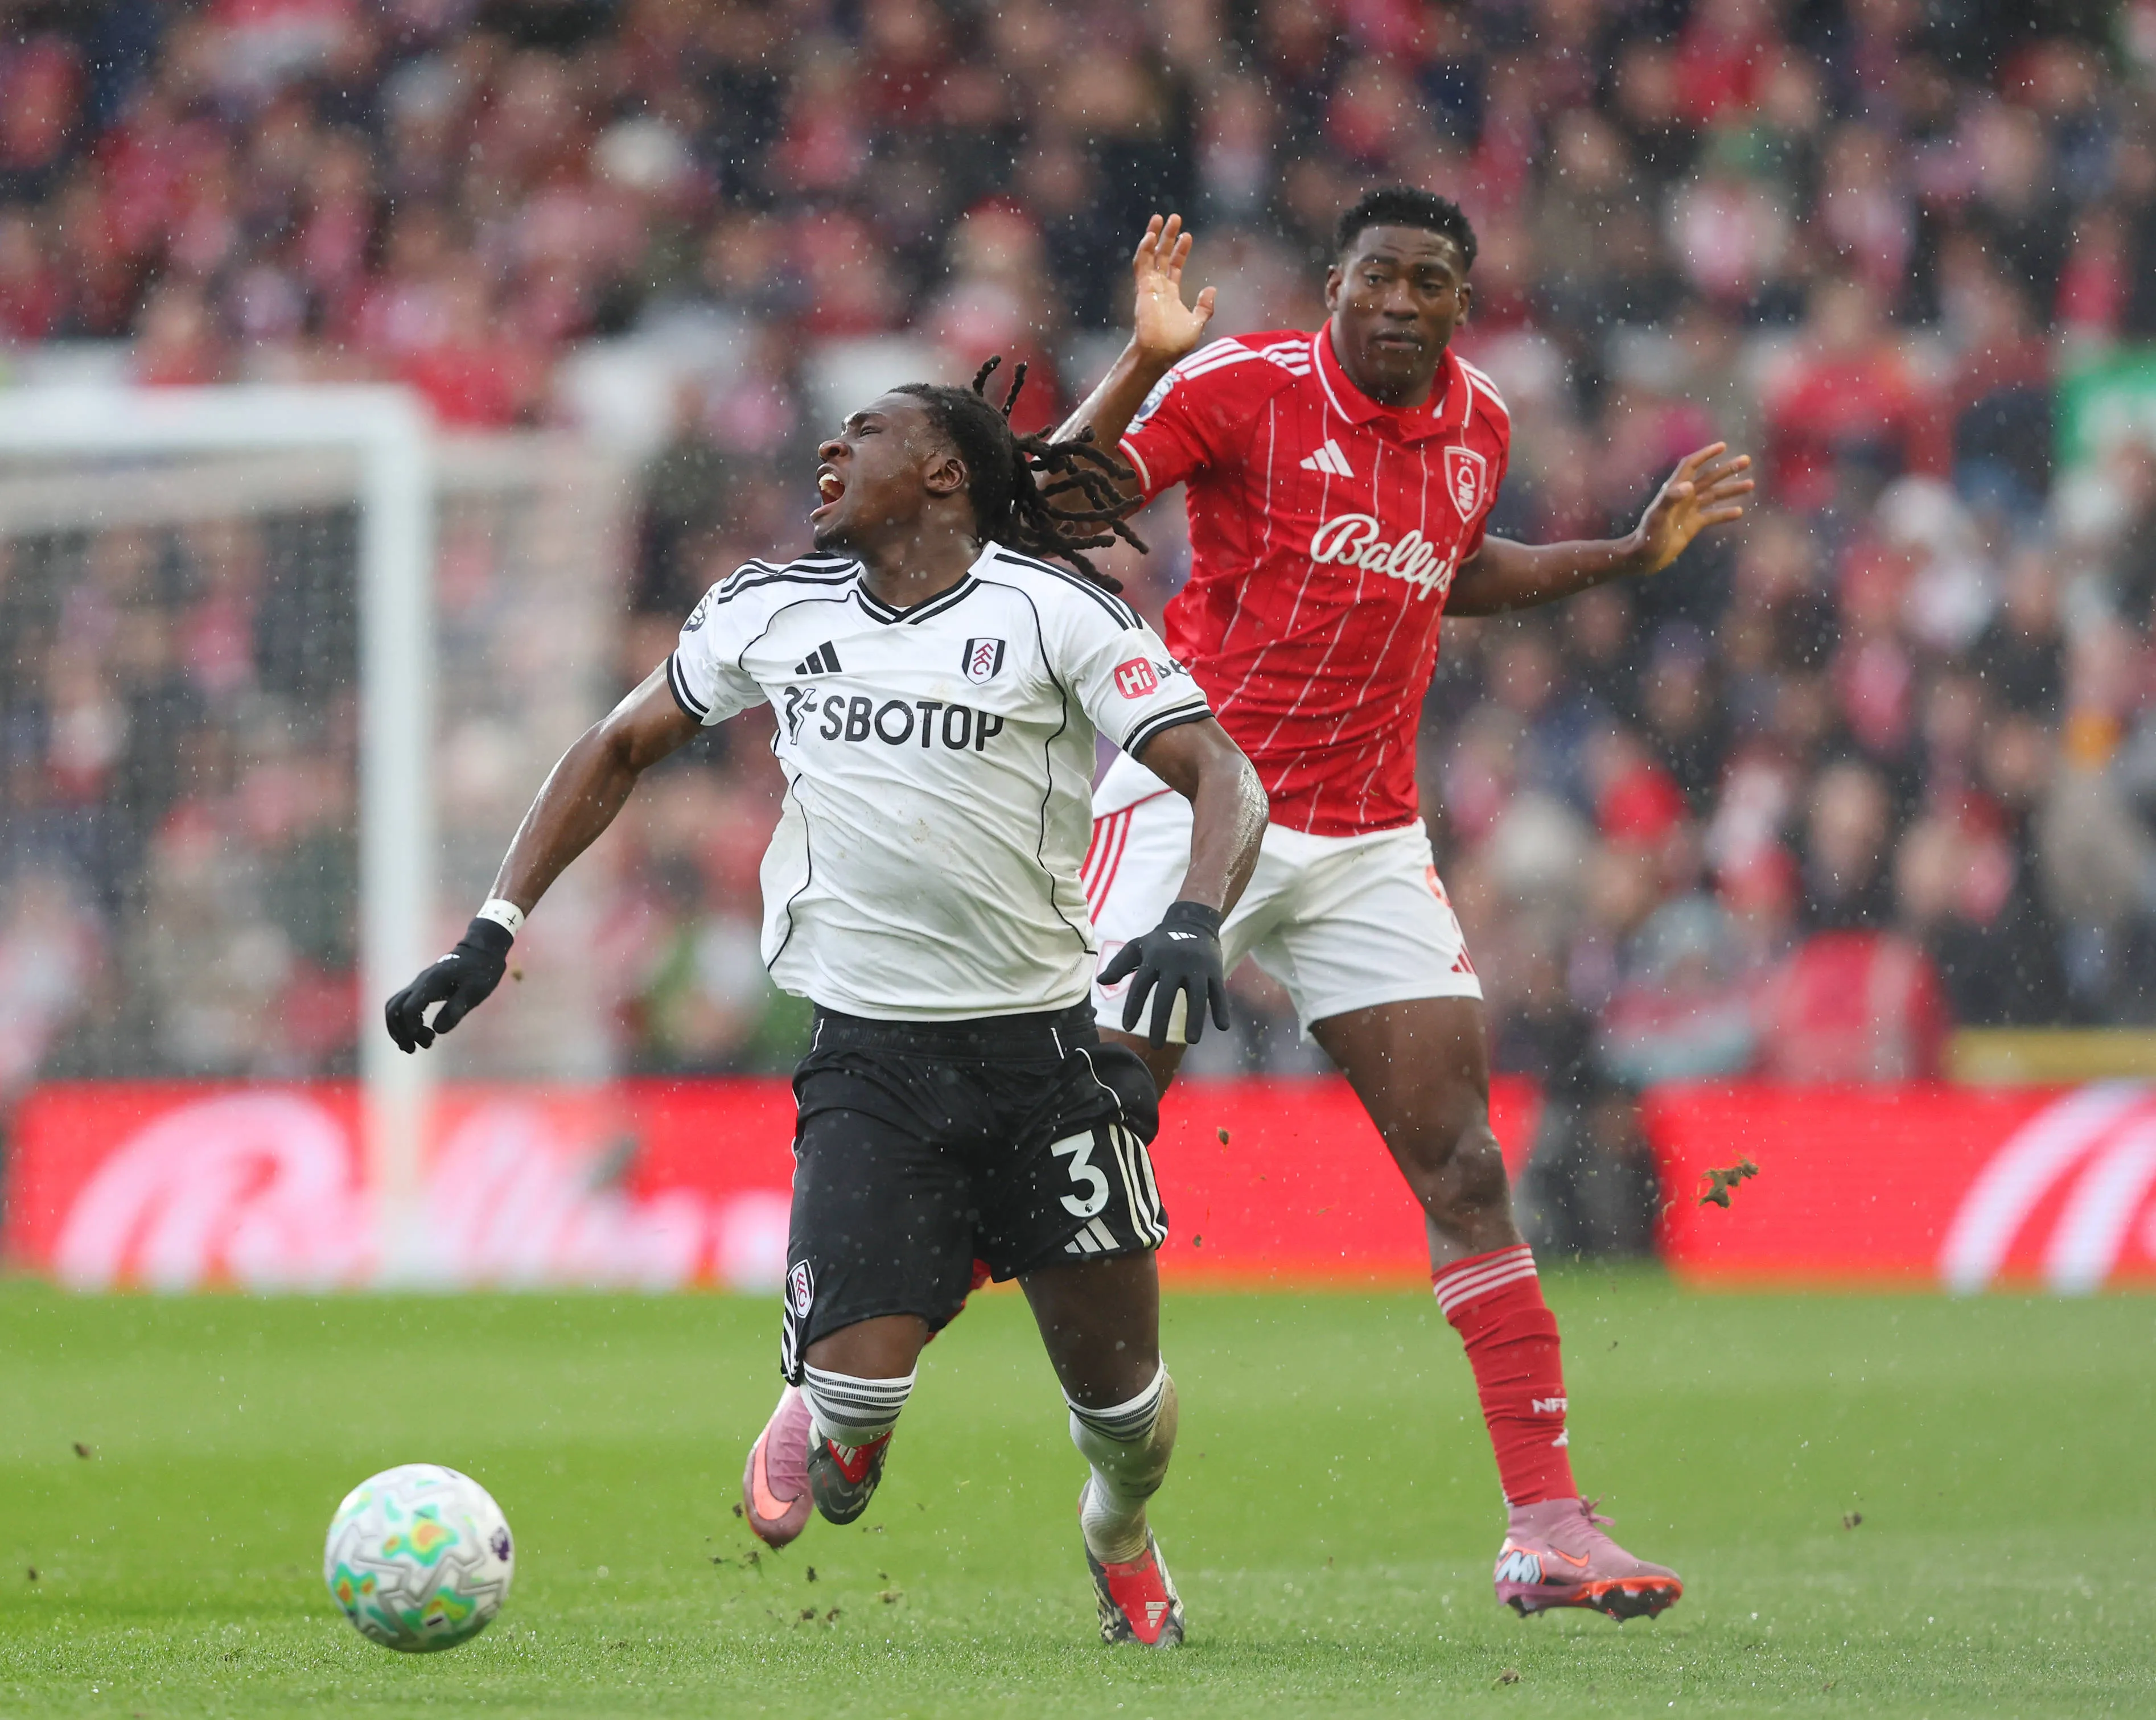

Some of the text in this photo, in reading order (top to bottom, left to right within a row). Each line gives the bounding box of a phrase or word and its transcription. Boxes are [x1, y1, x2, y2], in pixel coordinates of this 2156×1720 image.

[973, 643, 994, 675] FFC
[1119, 663, 1153, 695] Hi
[820, 695, 1003, 751] SBOTOP
[1051, 1129, 1109, 1217] 3
[796, 1272, 807, 1307] FFC
